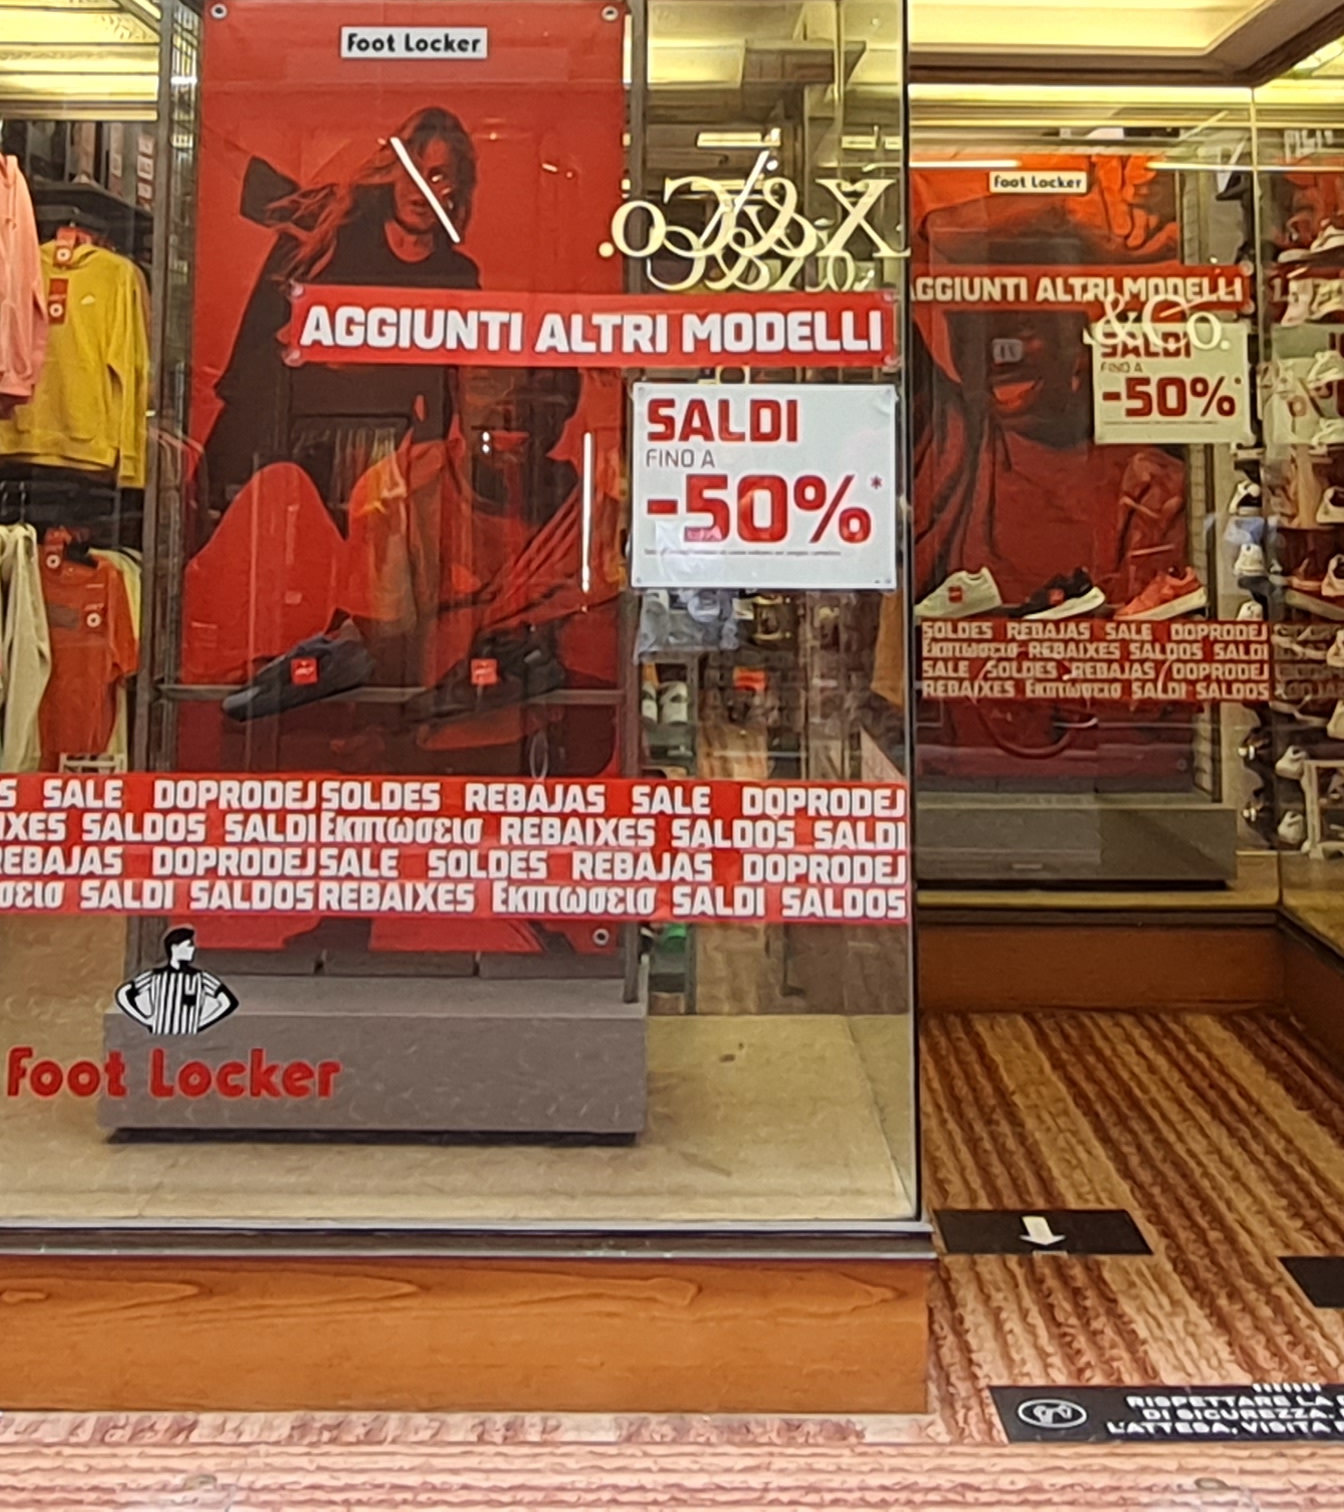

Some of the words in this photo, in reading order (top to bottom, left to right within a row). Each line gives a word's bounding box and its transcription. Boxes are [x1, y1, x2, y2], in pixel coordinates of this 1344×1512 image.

[347, 33, 396, 53] Foot
[404, 33, 481, 53] Locker
[993, 175, 1027, 189] Foot
[1032, 175, 1082, 189] Locker
[1035, 277, 1114, 303] ALTRI
[1121, 277, 1243, 303] MODELLI
[300, 305, 523, 352] AGGIUNTI
[534, 311, 668, 354] ALTRI
[681, 310, 884, 354] MODELLI
[646, 397, 799, 443] SALDI
[645, 448, 695, 469] FINO
[700, 448, 716, 469] A
[922, 620, 993, 639] SOLDES
[1006, 621, 1091, 640] REBAJAS
[1105, 622, 1153, 640] SALE
[1170, 623, 1268, 641] DOPRODEJ
[1028, 641, 1121, 659] REBAIXES
[1129, 642, 1204, 660] SALDOS
[1212, 642, 1269, 661] SALDI
[922, 660, 969, 678] SALE
[985, 661, 1057, 679] SOLDES
[1071, 662, 1156, 680] REBAJAS
[1171, 663, 1270, 681] DOPRODEJ
[921, 680, 1016, 698] REBAIXES
[1130, 681, 1187, 699] SALDI
[1195, 681, 1270, 700] SALDOS
[43, 778, 123, 809] SALE
[154, 779, 316, 811] DOPRODEJ
[320, 781, 441, 813] SOLDES
[464, 782, 606, 814] REBAJAS
[631, 784, 711, 816] SALE
[741, 786, 905, 819] DOPRODEJ
[81, 812, 207, 843] SALDOS
[224, 813, 316, 844] SALDI
[499, 815, 656, 847] REBAIXES
[671, 817, 796, 849] SALDOS
[813, 819, 906, 851] SALDI
[151, 846, 316, 877] DOPRODEJ
[319, 847, 400, 879] SALE
[427, 849, 548, 880] SOLDES
[571, 850, 713, 882] REBAJAS
[742, 852, 906, 885] DOPRODEJ
[80, 879, 174, 910] SALDI
[189, 879, 315, 910] SALDOS
[317, 881, 476, 913] REBAIXES
[672, 885, 765, 917] SALDI
[782, 887, 906, 919] SALDOS
[5, 1045, 128, 1099] Foot
[149, 1048, 343, 1101] Locker
[1296, 1394, 1333, 1408] LA
[1141, 1408, 1174, 1420] DI
